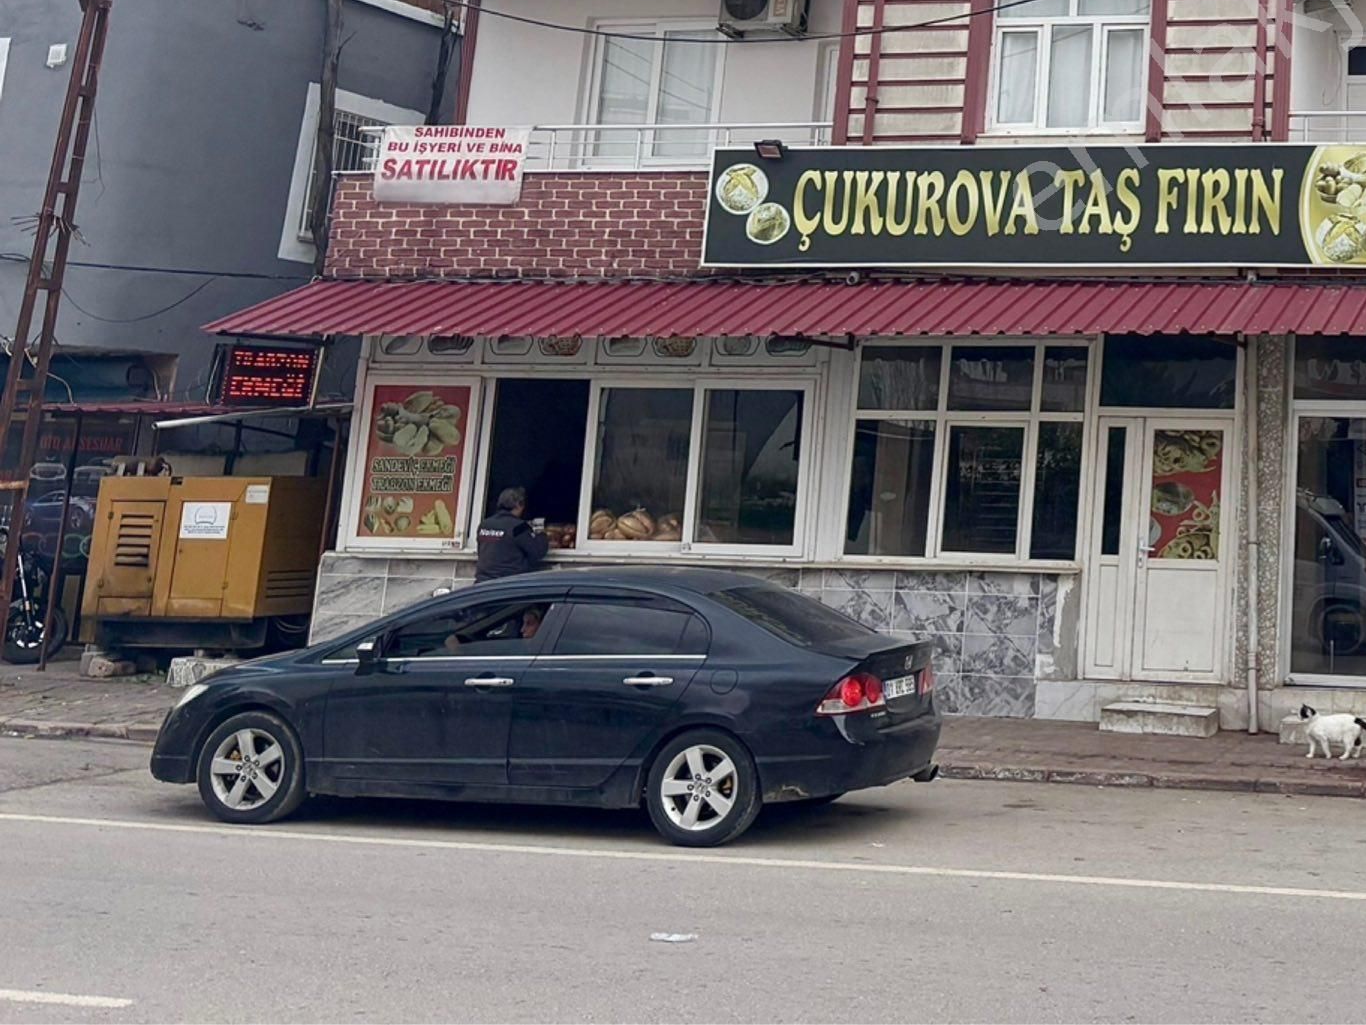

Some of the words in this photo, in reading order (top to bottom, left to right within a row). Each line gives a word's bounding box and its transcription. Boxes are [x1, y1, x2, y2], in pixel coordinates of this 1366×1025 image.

[387, 141, 409, 152] BU
[413, 139, 462, 154] İŞYERİ
[466, 142, 486, 153] VE
[489, 141, 523, 154] BİNA
[381, 158, 518, 181] SATILIKTIR
[793, 169, 1040, 252] ÇUKUROVA
[1053, 167, 1142, 252] TAŞ
[1154, 166, 1285, 236] FIRIN
